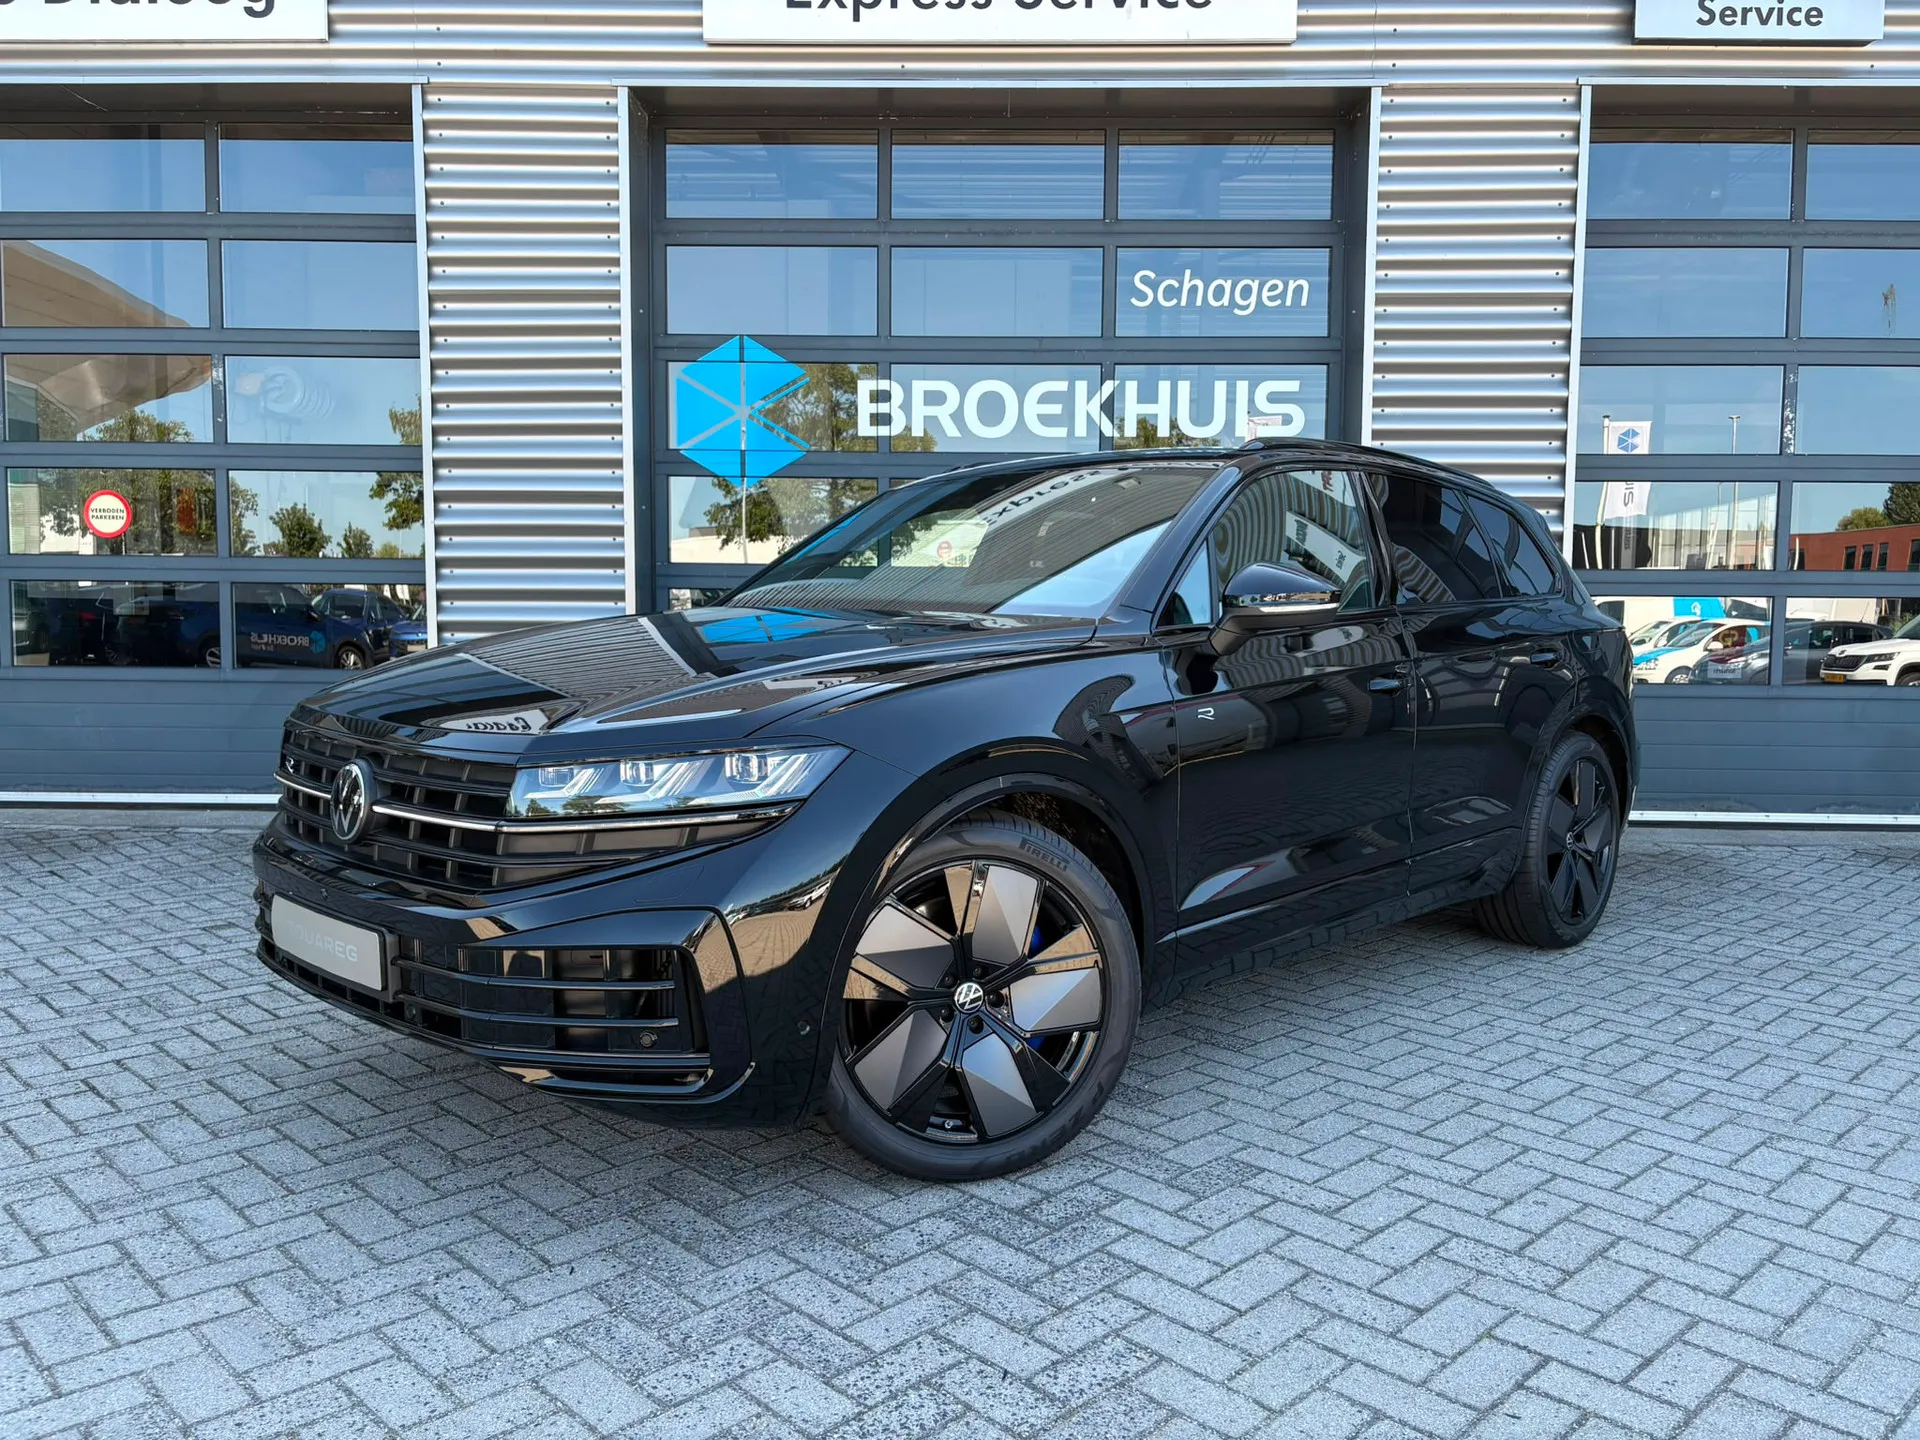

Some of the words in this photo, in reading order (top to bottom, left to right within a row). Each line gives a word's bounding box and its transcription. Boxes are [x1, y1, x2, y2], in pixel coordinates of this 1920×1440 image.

[1696, 0, 1824, 27] Service
[1130, 269, 1310, 316] Schagen
[857, 379, 1306, 438] BROEKHUIS
[1197, 707, 1215, 721] R
[1019, 836, 1070, 872] PIRELLI
[286, 920, 358, 962] TOUAREG
